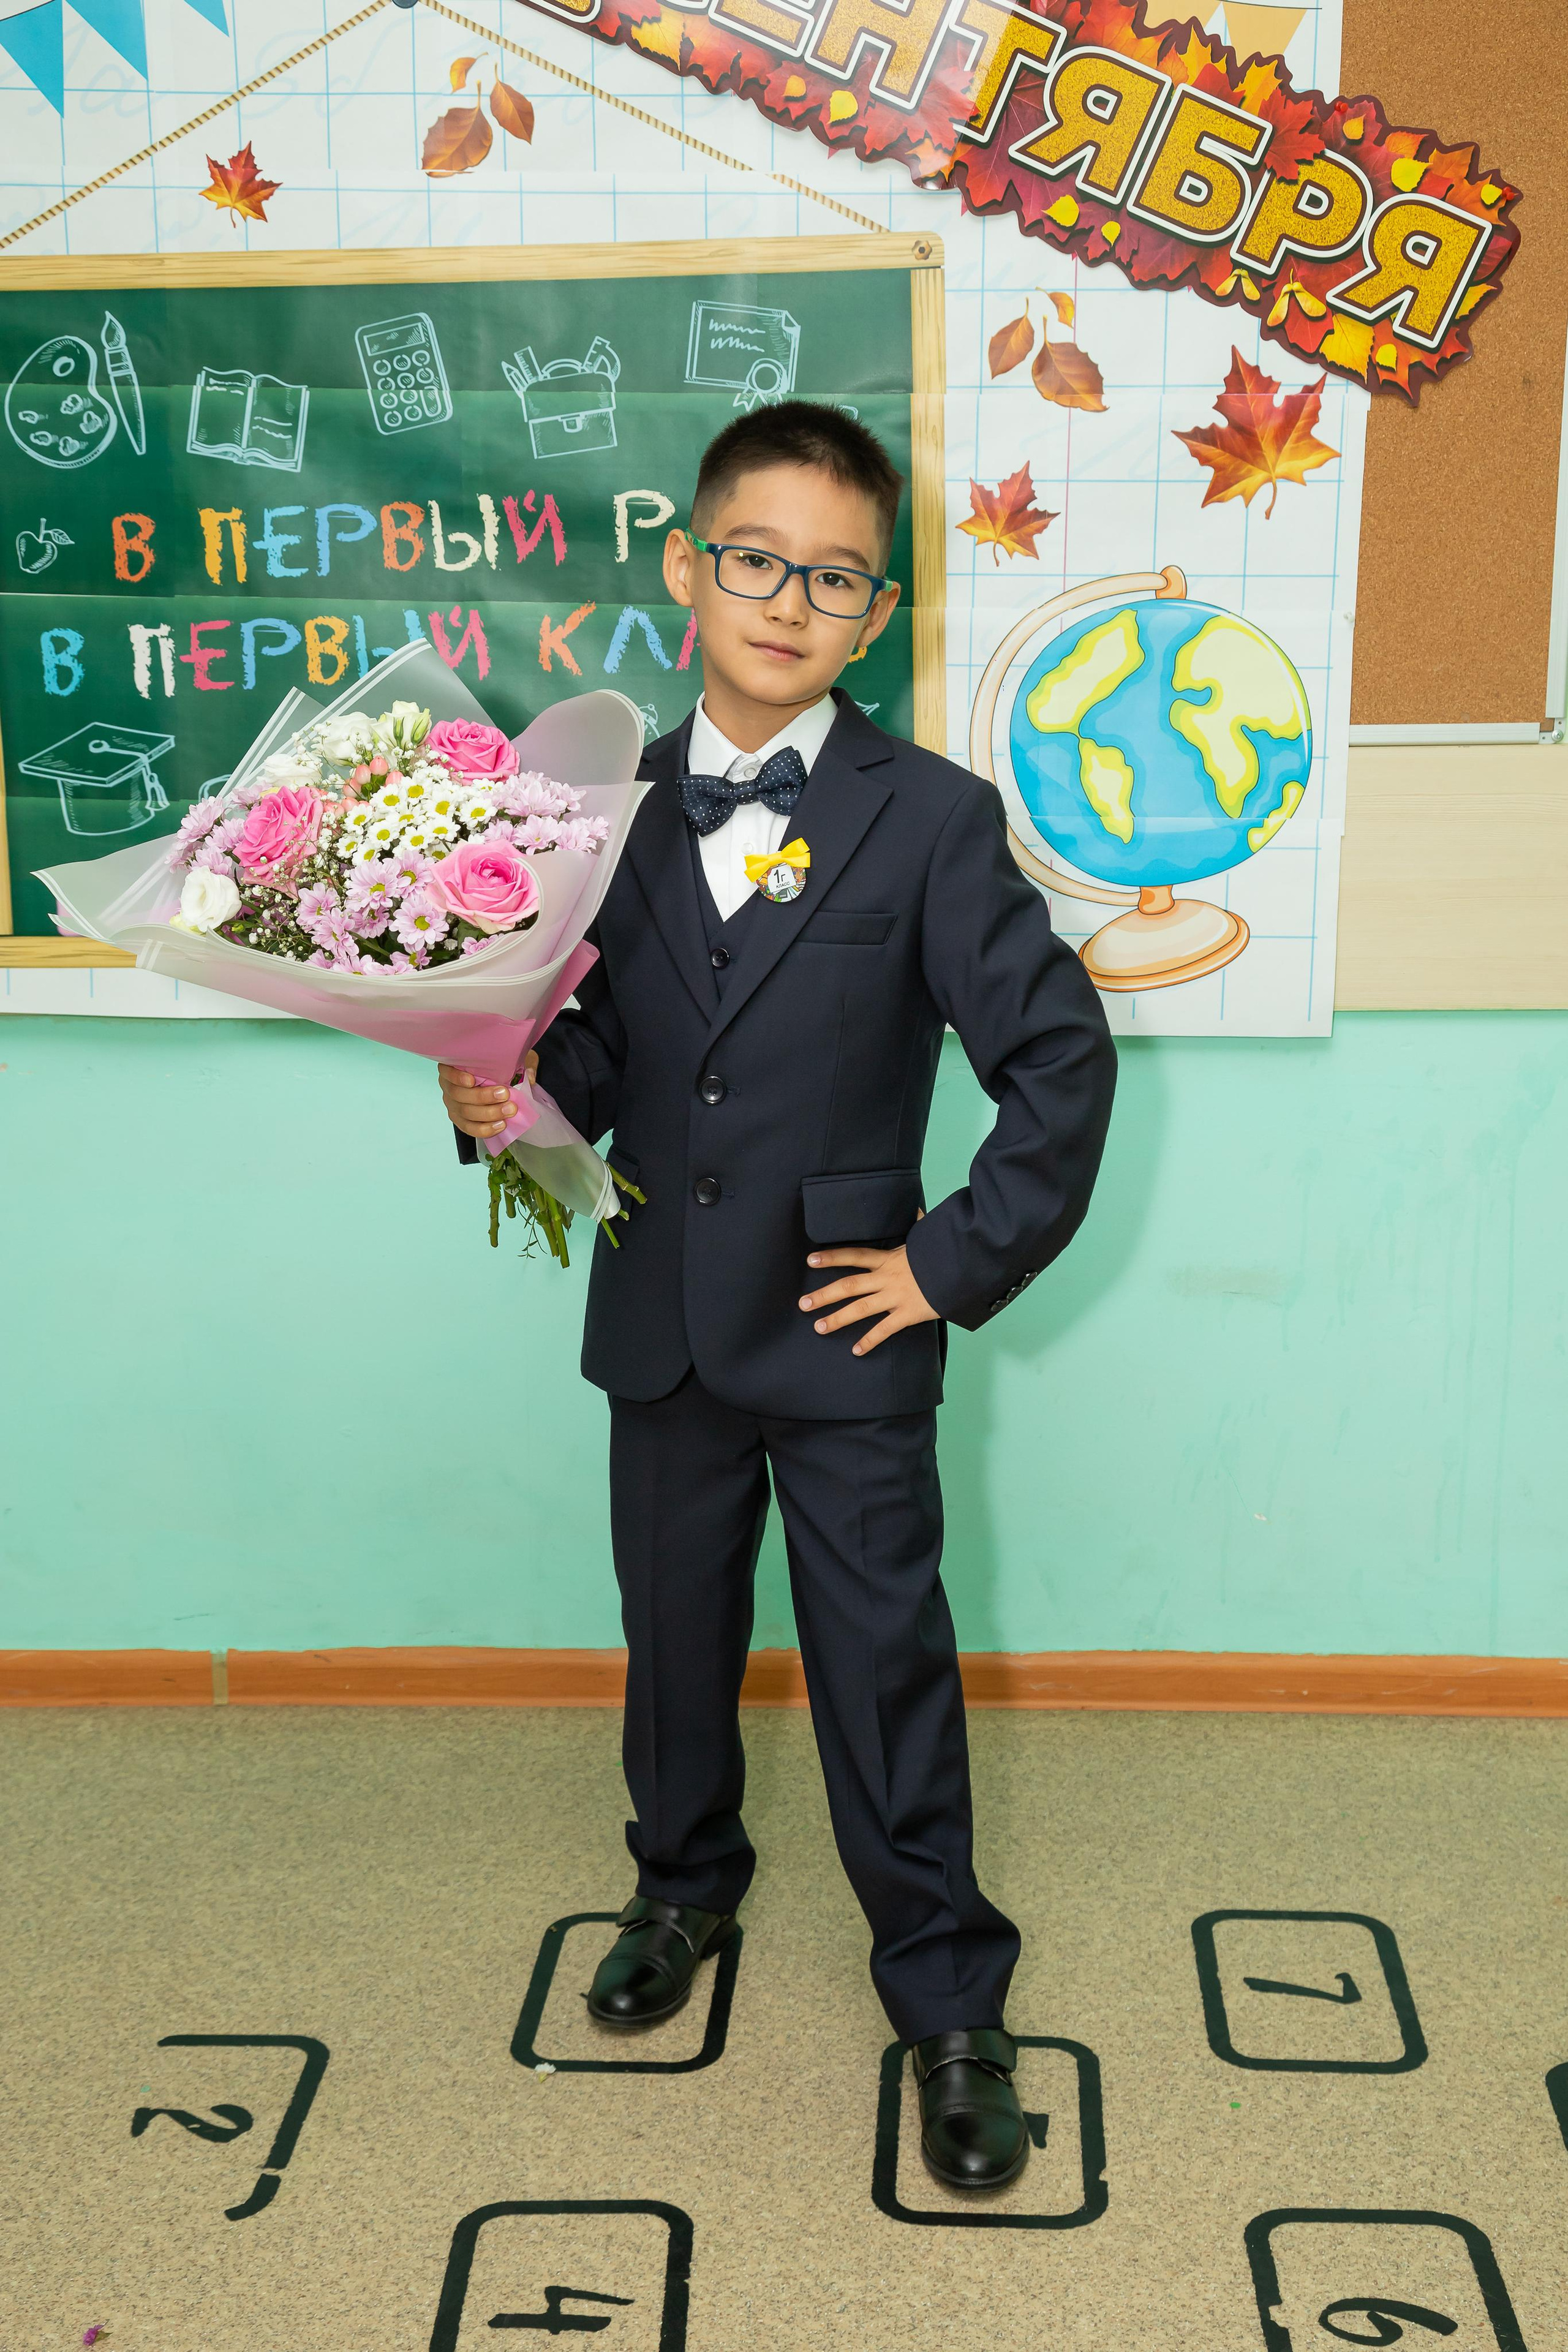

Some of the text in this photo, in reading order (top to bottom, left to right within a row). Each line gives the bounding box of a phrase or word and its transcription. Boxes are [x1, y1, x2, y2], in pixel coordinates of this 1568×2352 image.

[662, 0, 1493, 349] НТЯБРЯ
[112, 513, 156, 583] В
[198, 489, 567, 586] ПЕРВЫЙ
[40, 628, 85, 697] В
[131, 2104, 254, 2143] 2
[488, 2285, 635, 2335] 4
